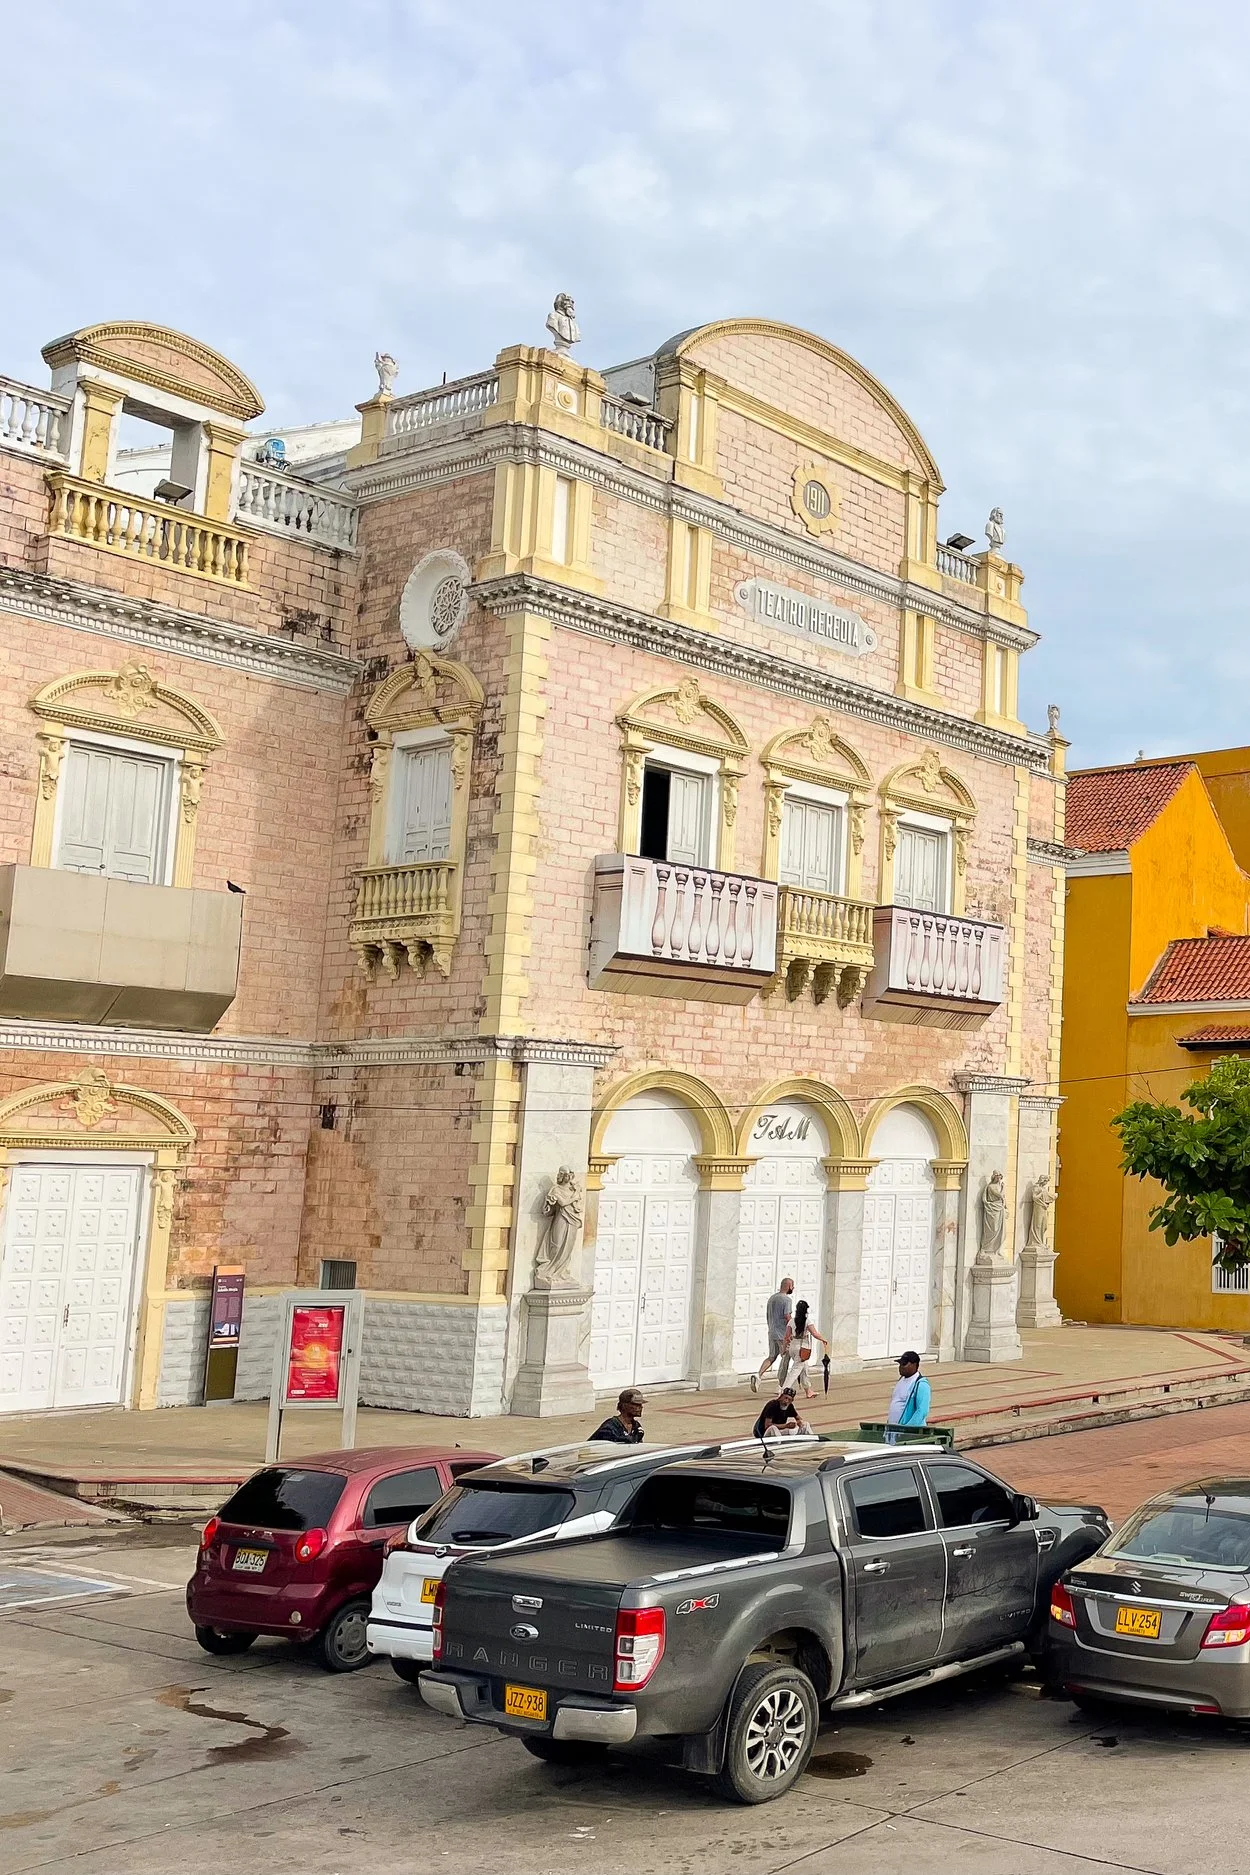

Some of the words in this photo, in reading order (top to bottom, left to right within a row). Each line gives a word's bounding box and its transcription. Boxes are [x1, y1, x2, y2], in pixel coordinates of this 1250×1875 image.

[806, 484, 825, 515] 1911
[757, 587, 806, 628] TEATRO
[809, 607, 859, 648] HEREDIA
[574, 1622, 613, 1633] LIMITED
[446, 1641, 609, 1681] RANGER
